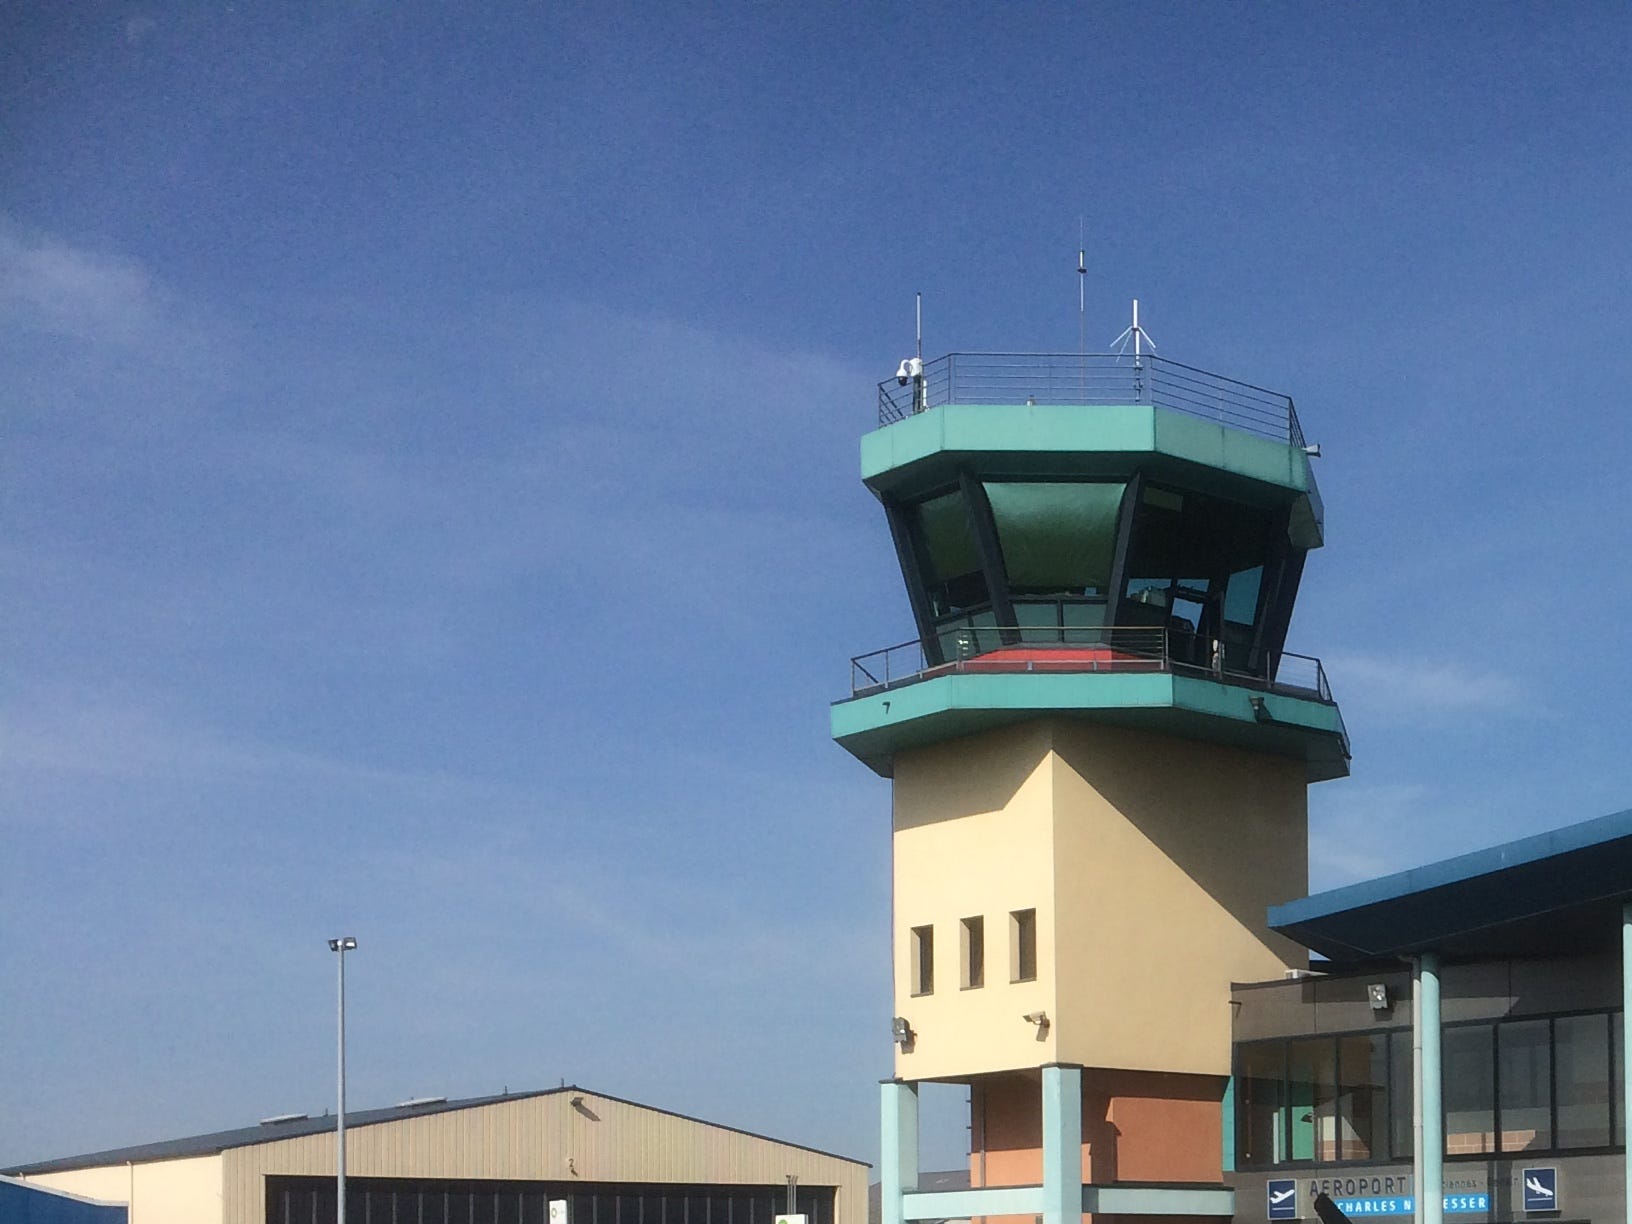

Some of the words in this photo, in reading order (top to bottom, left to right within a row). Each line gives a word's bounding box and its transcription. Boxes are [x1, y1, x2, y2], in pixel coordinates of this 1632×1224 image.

[1309, 1176, 1406, 1197] AEROPORT
[1337, 1200, 1396, 1213] CHARLES
[1403, 1197, 1486, 1211] NESSER
